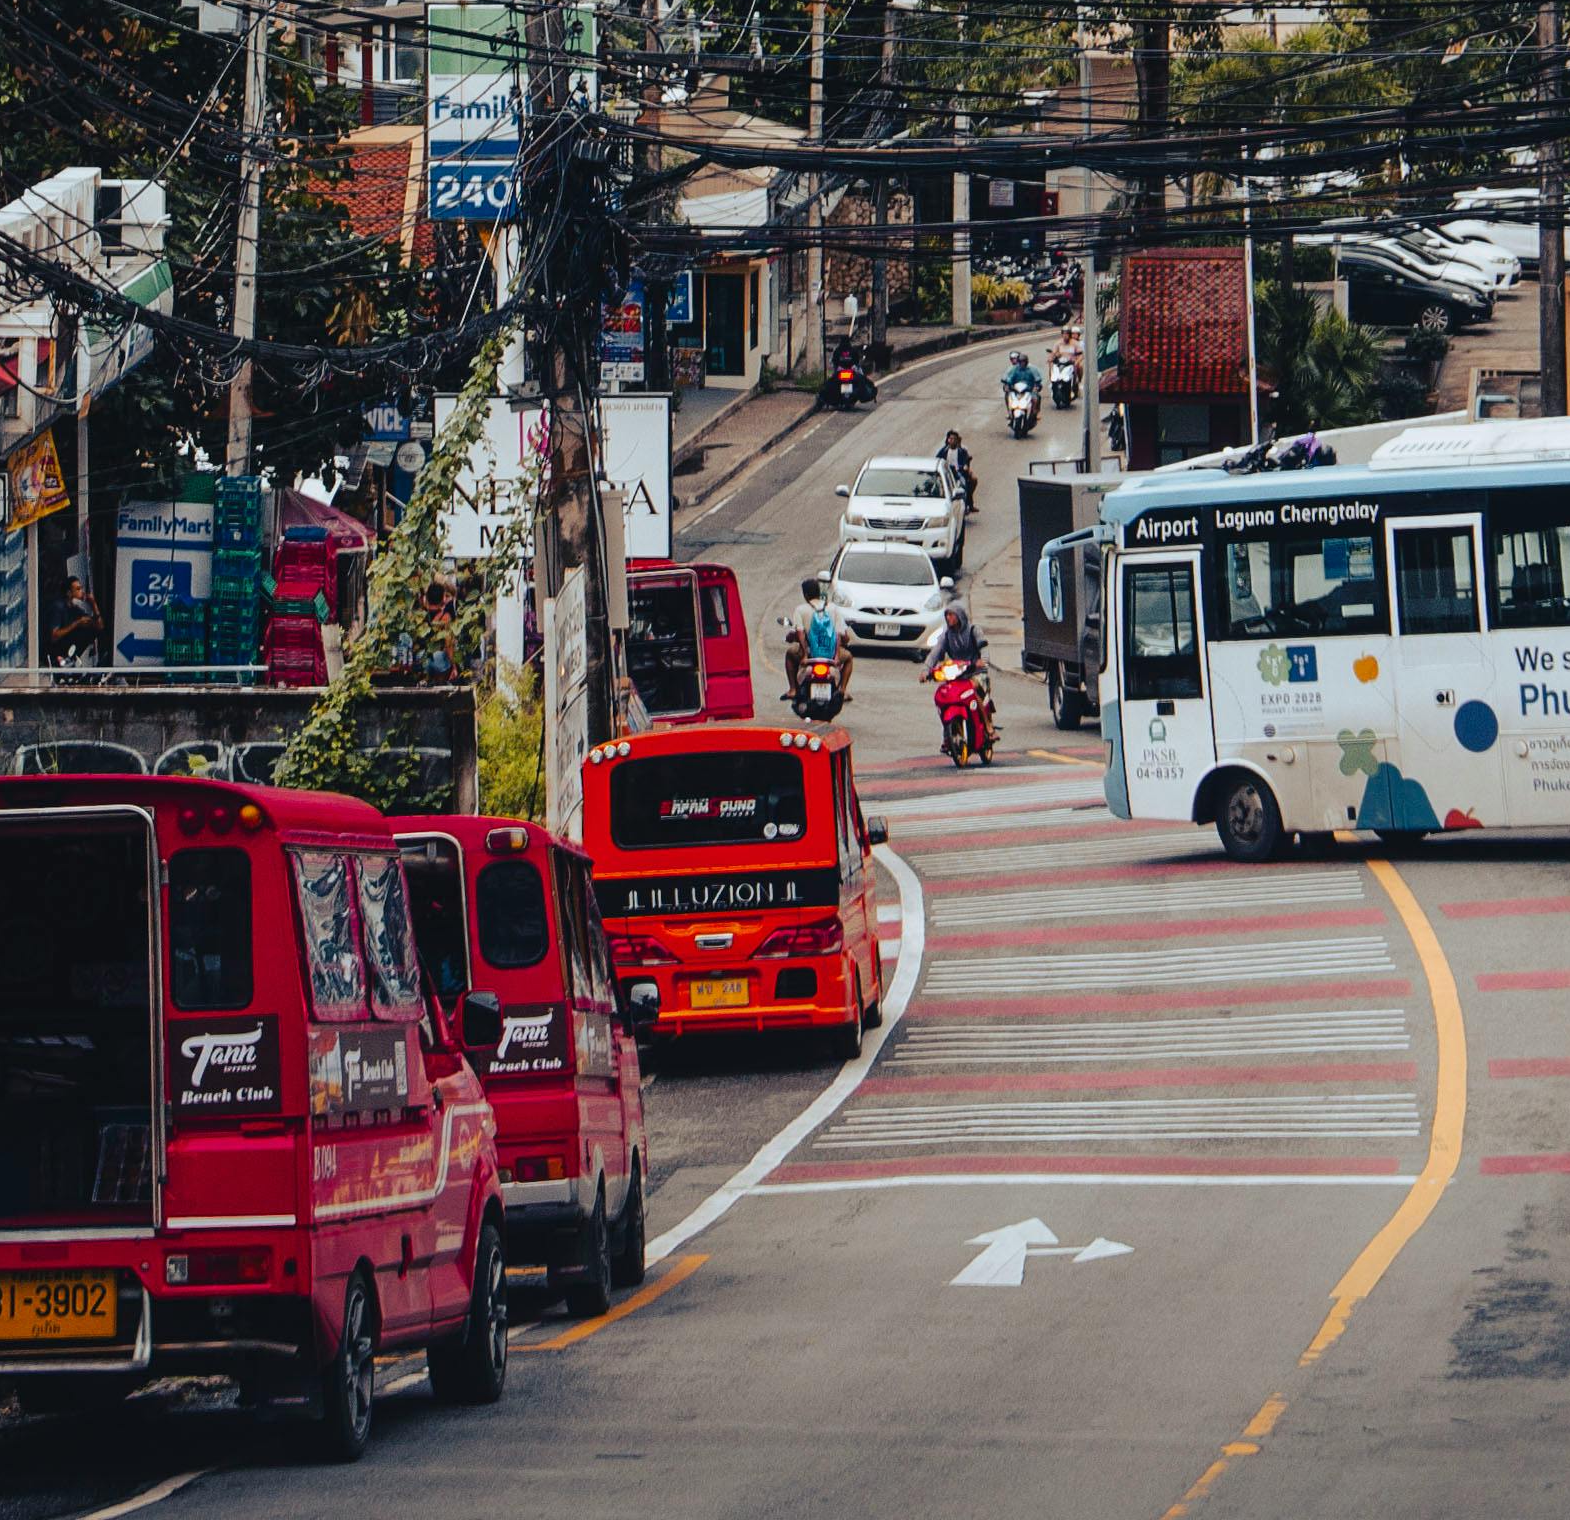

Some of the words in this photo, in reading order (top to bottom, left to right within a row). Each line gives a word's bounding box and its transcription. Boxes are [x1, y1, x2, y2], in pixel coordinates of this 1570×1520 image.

[434, 95, 532, 125] Family
[119, 514, 211, 534] FamilyMart
[1136, 516, 1199, 542] Airport
[1216, 509, 1275, 531] Laguna
[1280, 501, 1379, 526] Cherngtalay
[149, 573, 174, 590] 24
[1515, 646, 1554, 672] We
[1261, 693, 1290, 705] EXPO
[652, 882, 774, 908] ILLUZION
[181, 1027, 262, 1087] Tann
[490, 1059, 529, 1073] Beach
[532, 1057, 562, 1071] Club
[181, 1087, 231, 1105] Beach
[236, 1085, 273, 1101] Club
